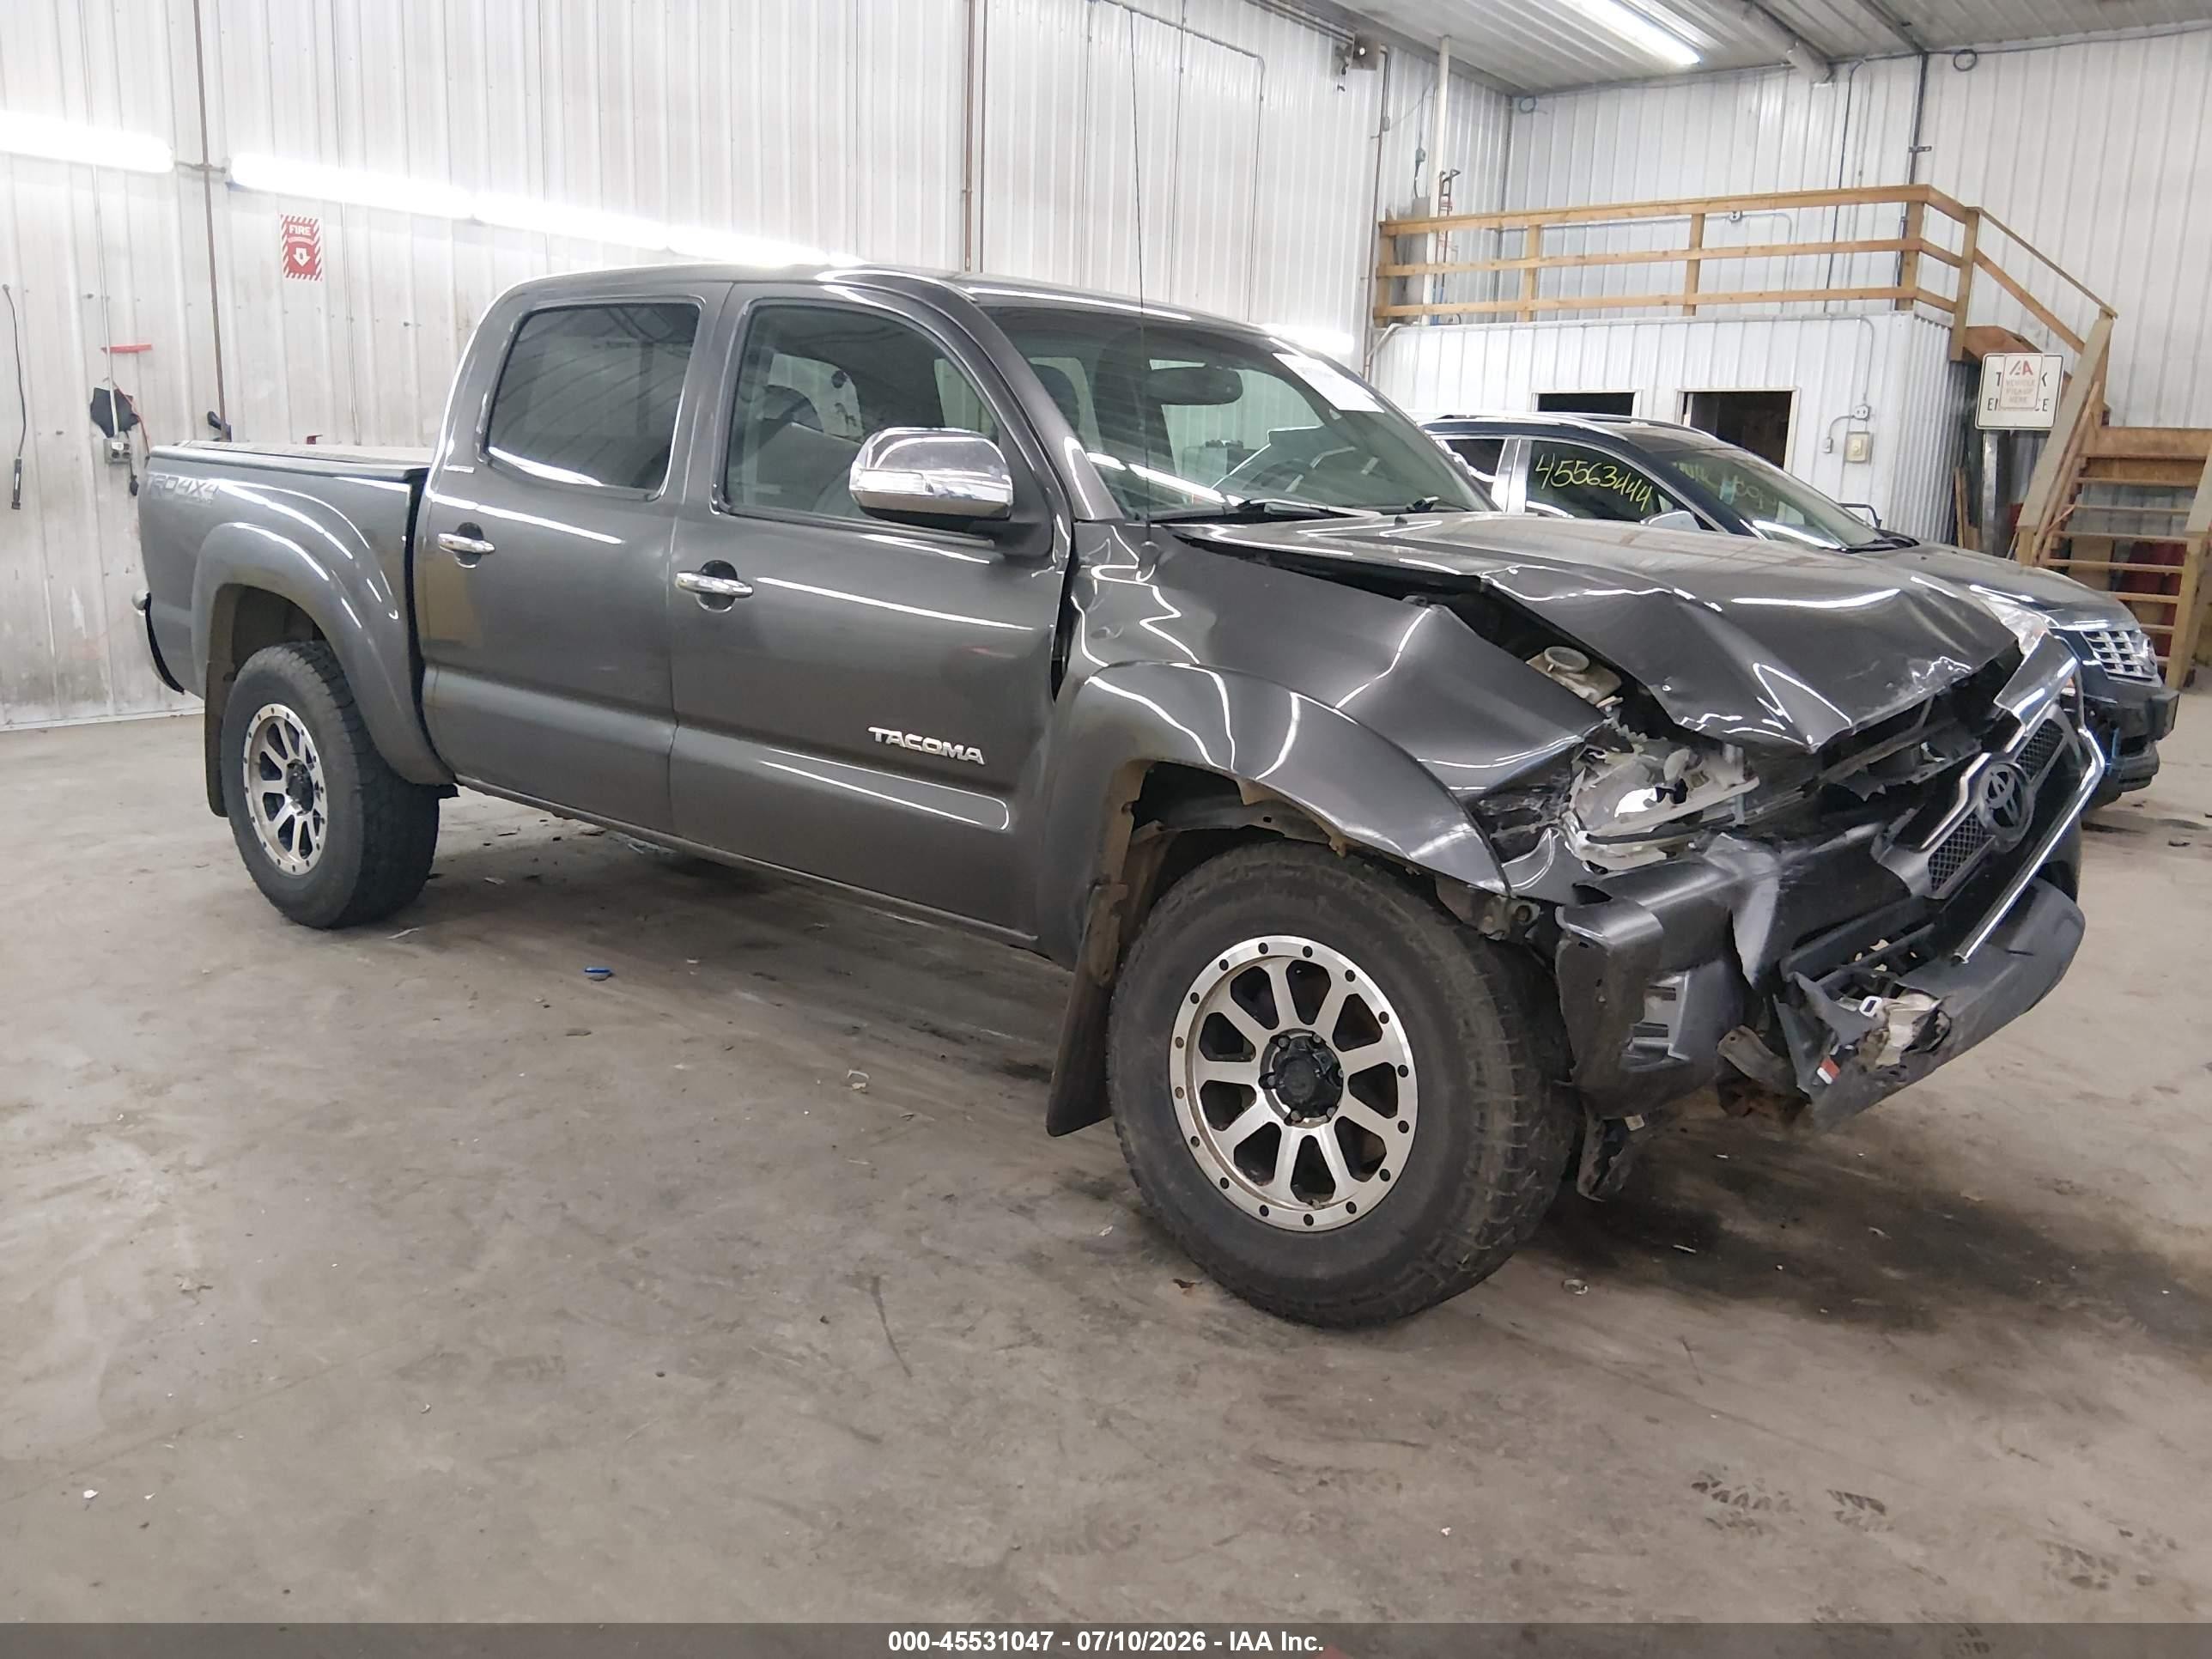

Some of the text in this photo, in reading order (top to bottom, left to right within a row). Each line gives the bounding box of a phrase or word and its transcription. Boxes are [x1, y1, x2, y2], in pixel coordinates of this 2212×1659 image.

[289, 225, 311, 236] FIRE
[1534, 453, 1653, 513] 45563444
[867, 726, 986, 766] TACOMA
